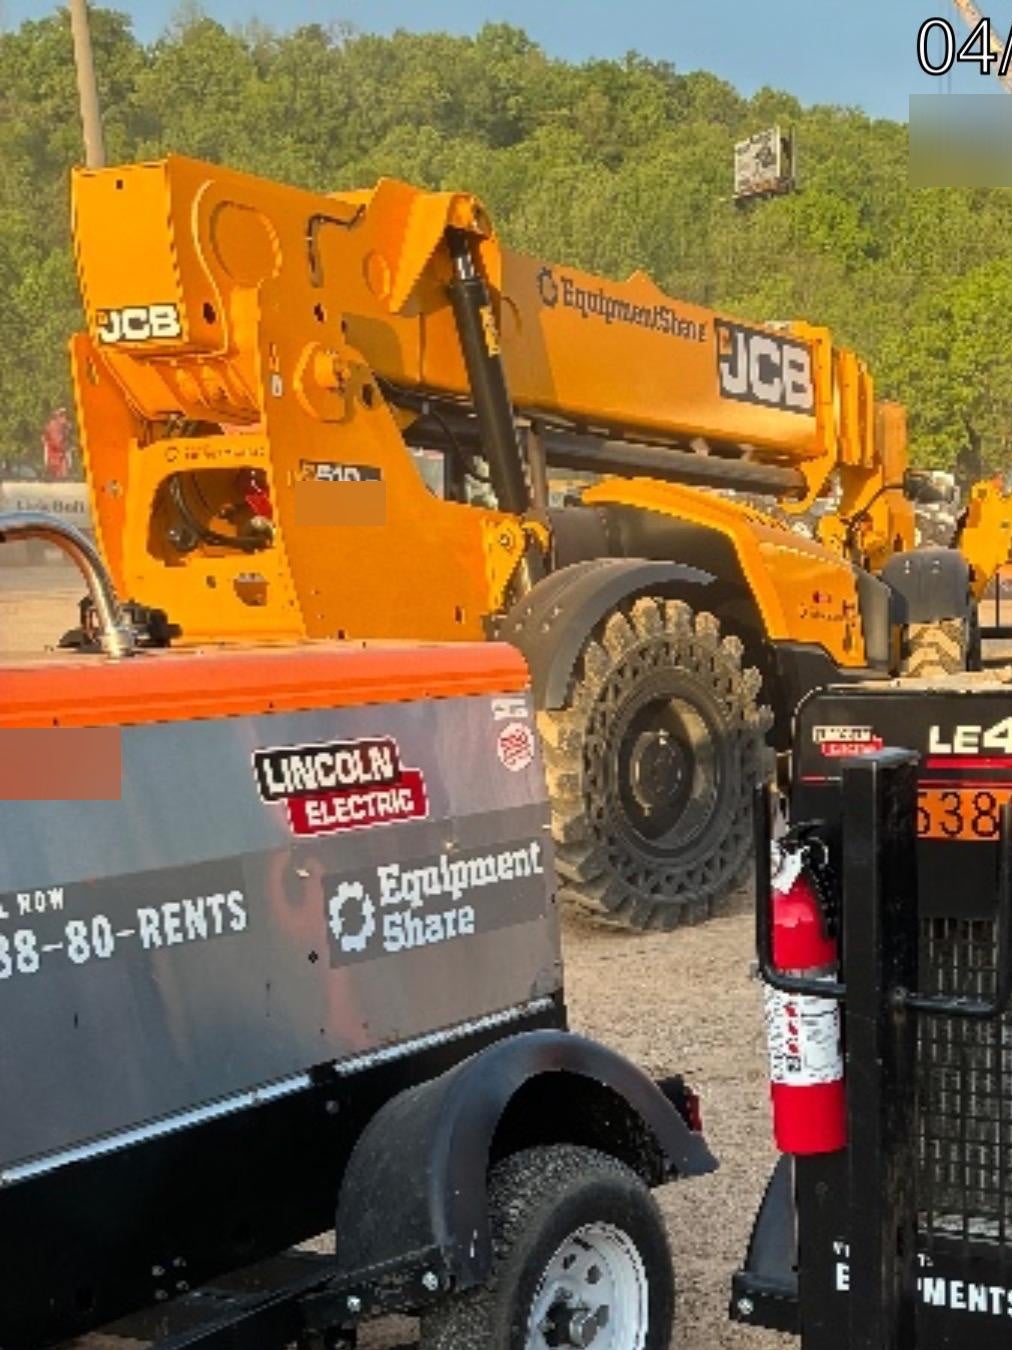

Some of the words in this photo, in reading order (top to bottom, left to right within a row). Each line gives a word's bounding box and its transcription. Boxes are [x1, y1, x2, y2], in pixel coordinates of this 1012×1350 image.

[98, 305, 181, 343] JCB
[560, 275, 708, 344] EquipmentShare
[719, 328, 814, 410] JCB
[262, 745, 394, 794] LINCOLN
[304, 788, 415, 826] ELECTRIC
[376, 841, 544, 909] Equipment
[16, 887, 64, 916] NOW
[382, 904, 475, 952] Share
